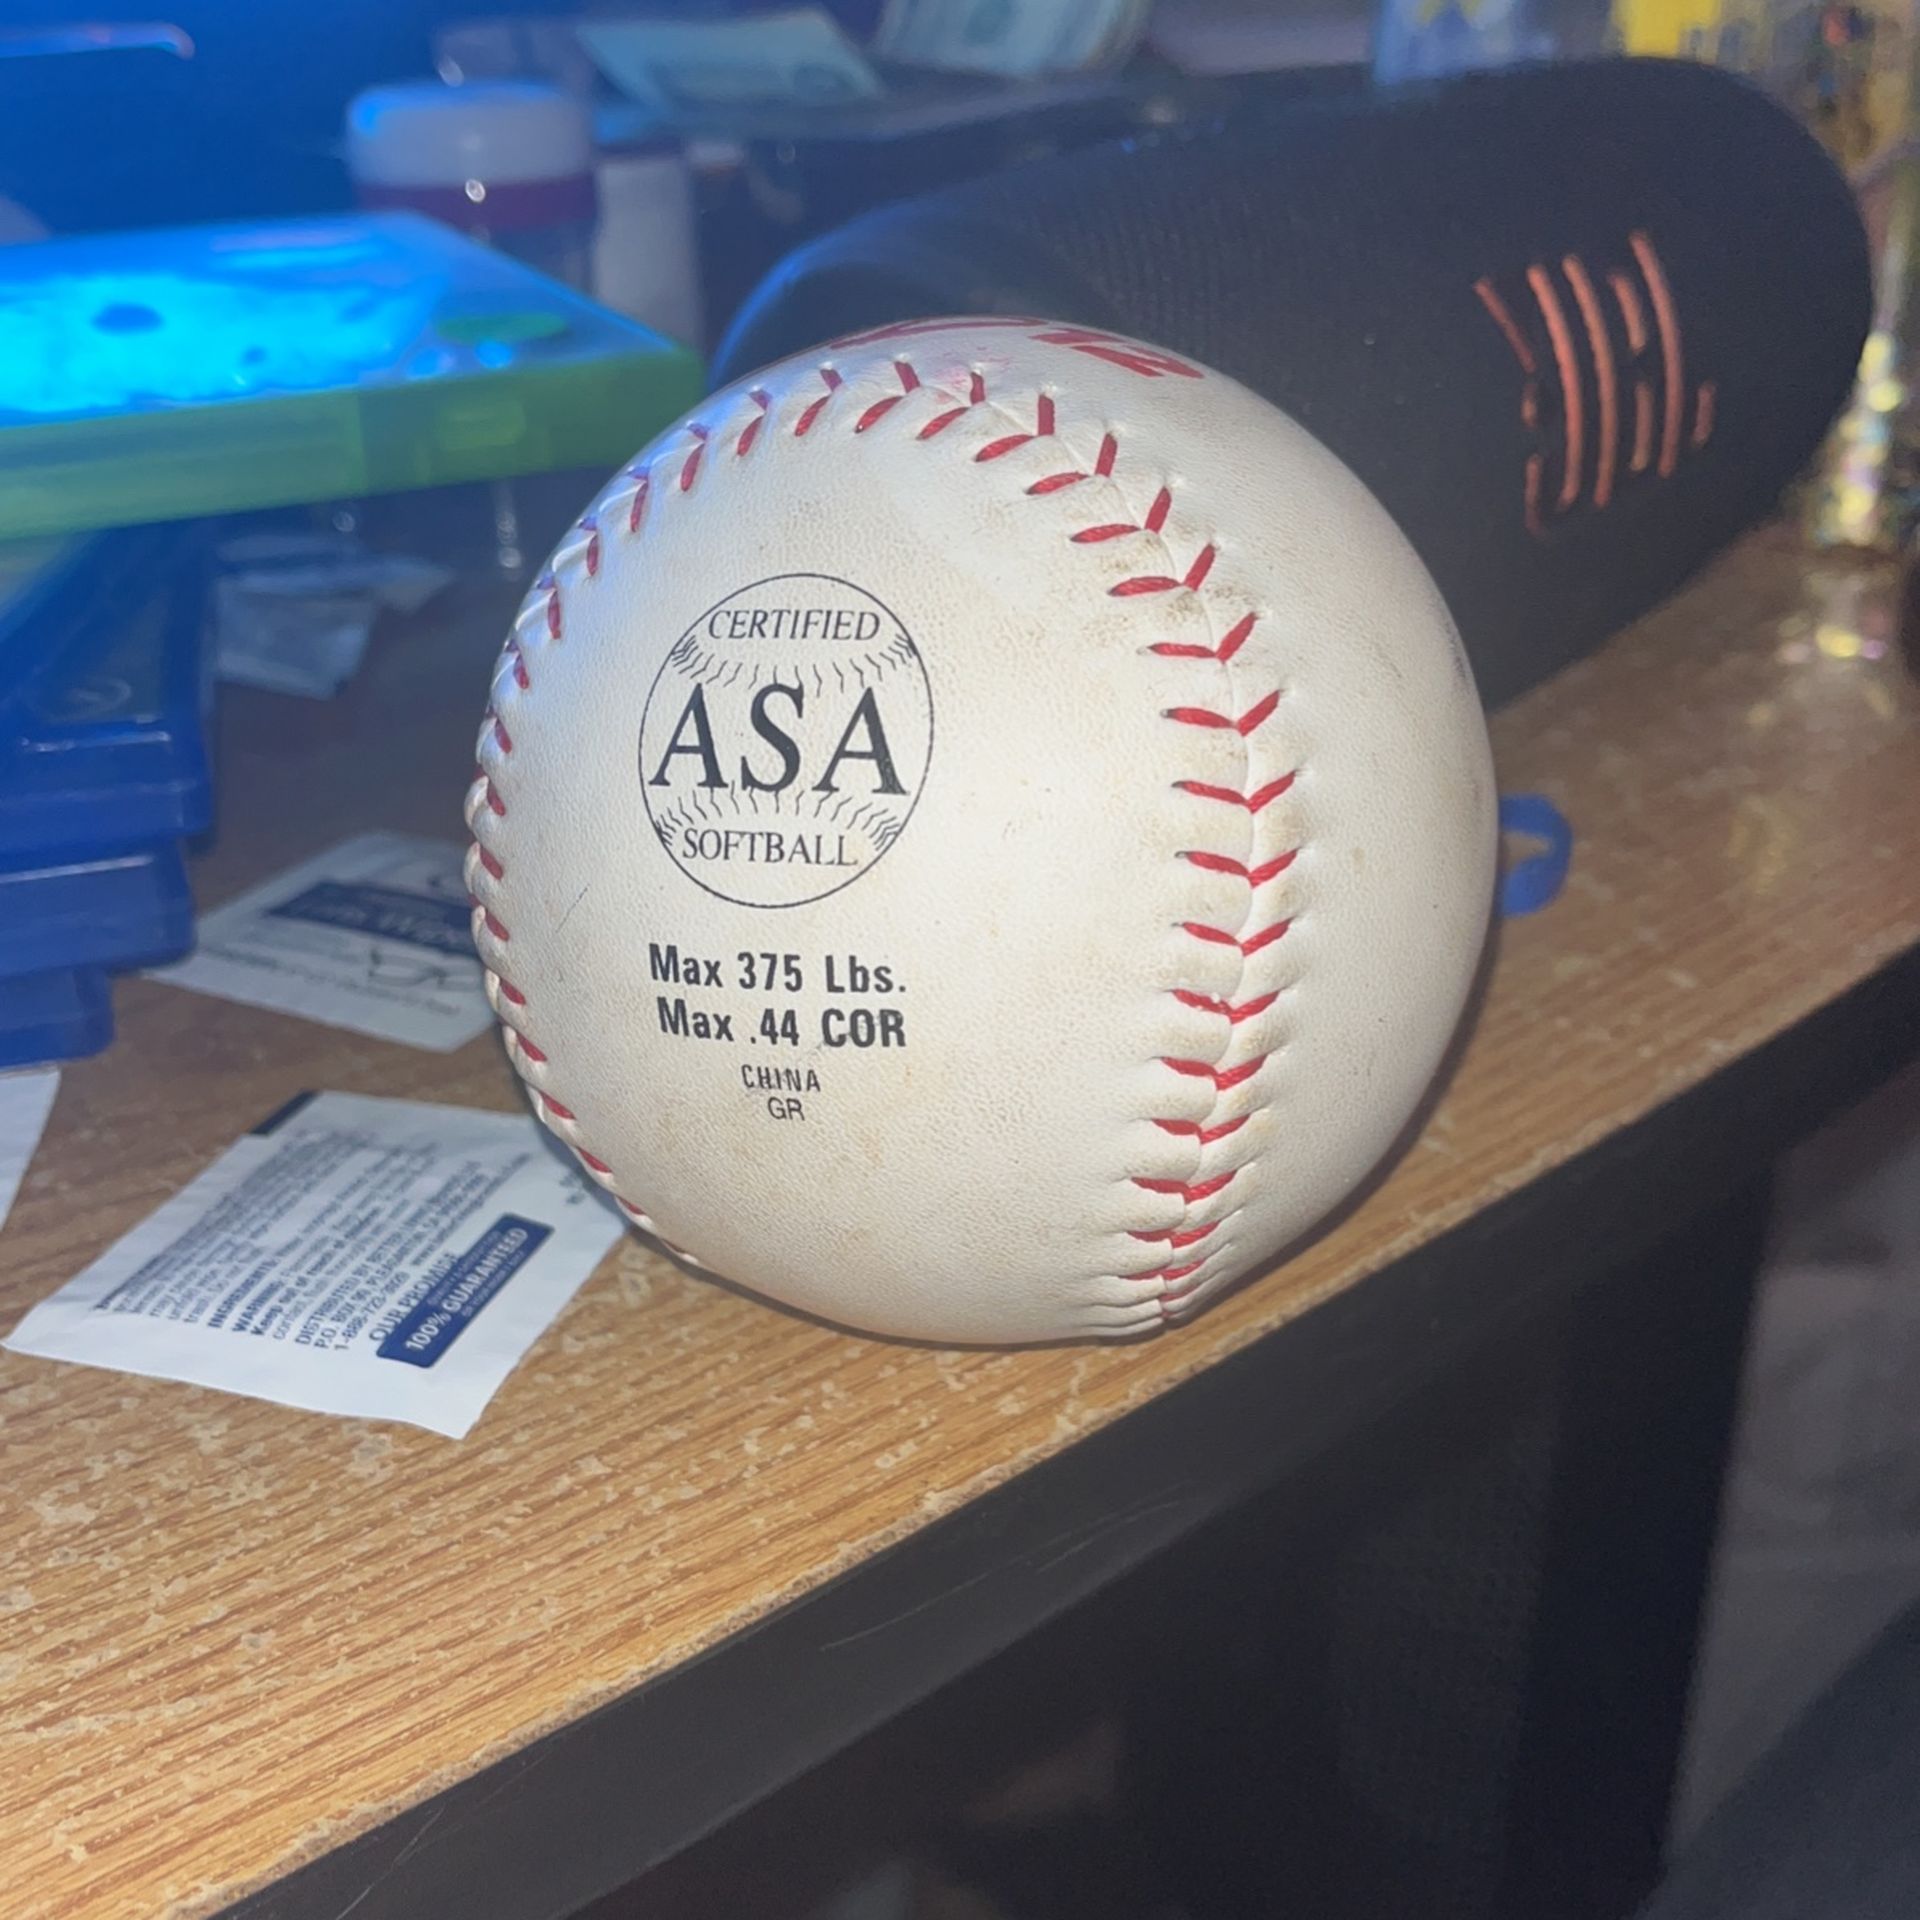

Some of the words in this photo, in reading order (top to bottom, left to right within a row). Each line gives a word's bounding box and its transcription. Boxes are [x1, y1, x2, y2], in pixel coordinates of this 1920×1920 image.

[708, 609, 880, 642] CERTIFIED
[649, 683, 911, 796] ASA
[682, 827, 859, 867] SOFTBALL
[649, 944, 723, 988] Max
[738, 952, 803, 992] 375
[825, 954, 906, 994] Lbs.
[656, 997, 734, 1043] Max
[750, 1008, 800, 1046] .44
[822, 1009, 906, 1047] COR
[741, 1064, 821, 1093] CHINA
[767, 1098, 806, 1121] GR
[295, 1277, 359, 1344] DISTRIBUTED
[366, 1308, 407, 1342] OUR
[396, 1252, 462, 1308] PROMISE
[402, 1310, 452, 1350] 100%
[439, 1227, 532, 1311] GUARANTEED
[250, 1305, 283, 1335] Keep
